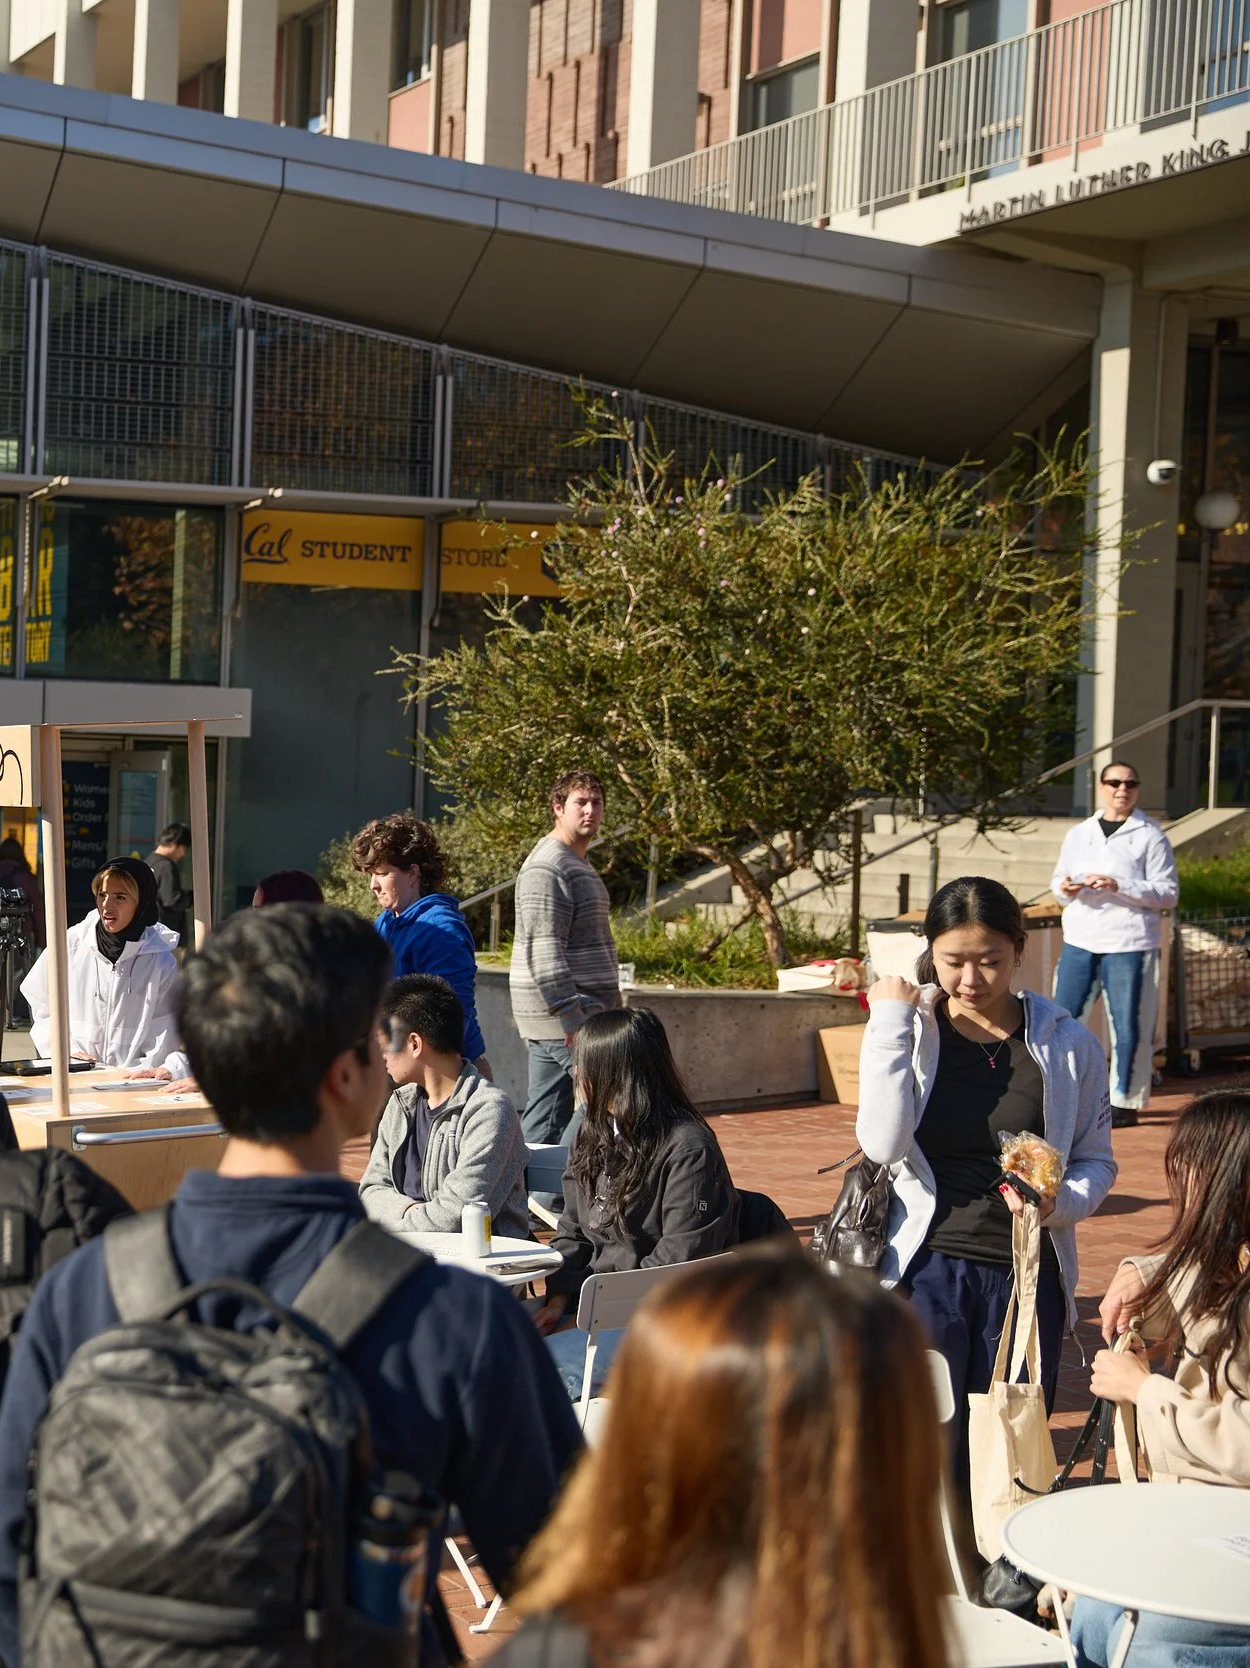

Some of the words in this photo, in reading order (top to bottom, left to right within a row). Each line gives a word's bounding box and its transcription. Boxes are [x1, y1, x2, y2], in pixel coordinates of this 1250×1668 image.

[959, 189, 1046, 230] MARTIN
[1055, 161, 1151, 202] LUTHER
[1161, 138, 1230, 176] KING
[242, 522, 293, 565] Cal
[301, 540, 412, 563] STUDENT
[441, 547, 508, 568] STORE
[72, 797, 96, 809] Kids
[72, 811, 103, 823] Order
